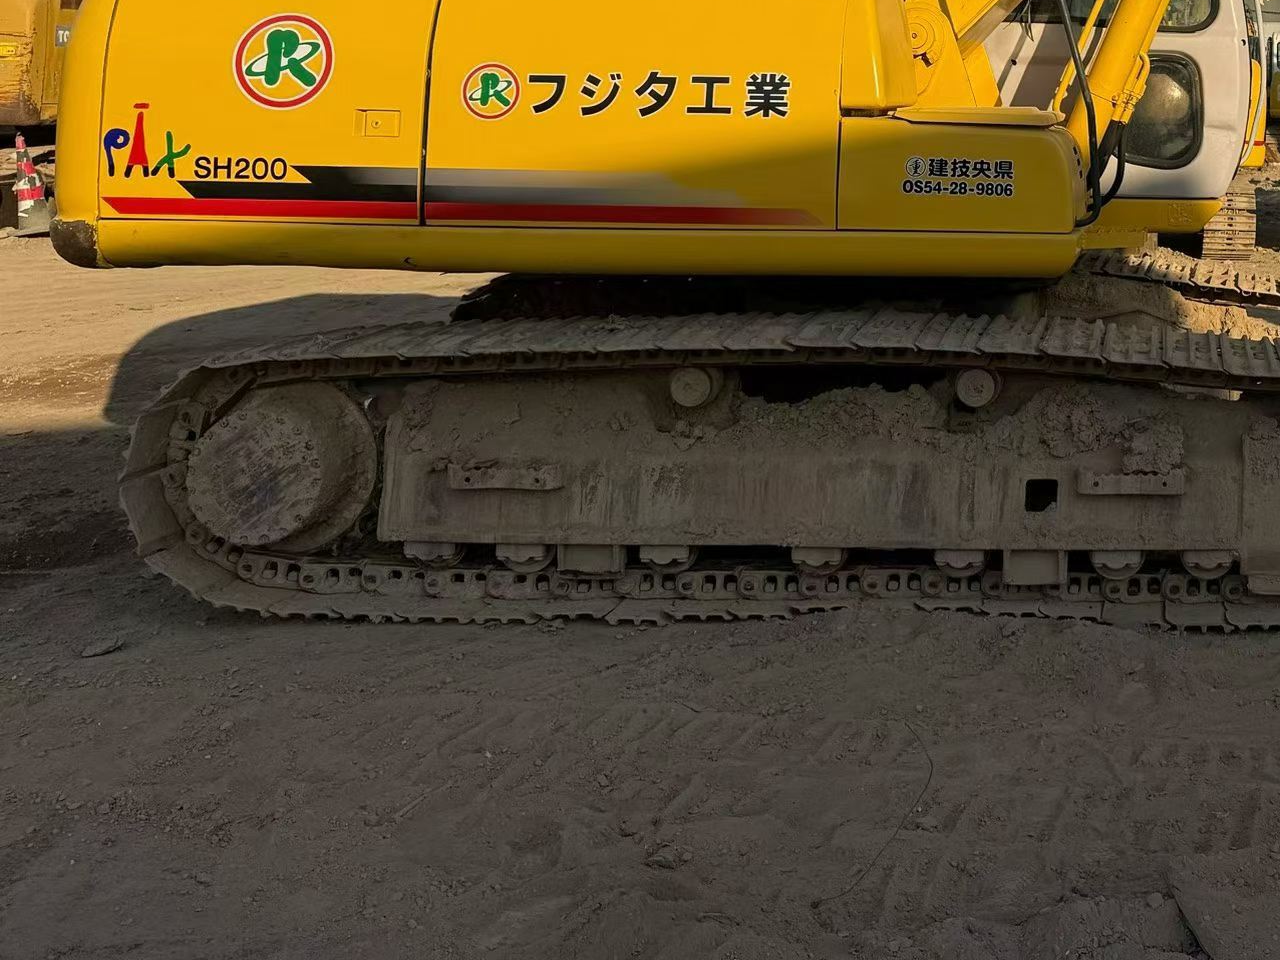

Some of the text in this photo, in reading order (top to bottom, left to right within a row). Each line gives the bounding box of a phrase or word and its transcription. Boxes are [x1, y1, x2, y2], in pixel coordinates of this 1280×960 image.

[527, 71, 792, 118] フジタ工業
[193, 156, 288, 180] SH200
